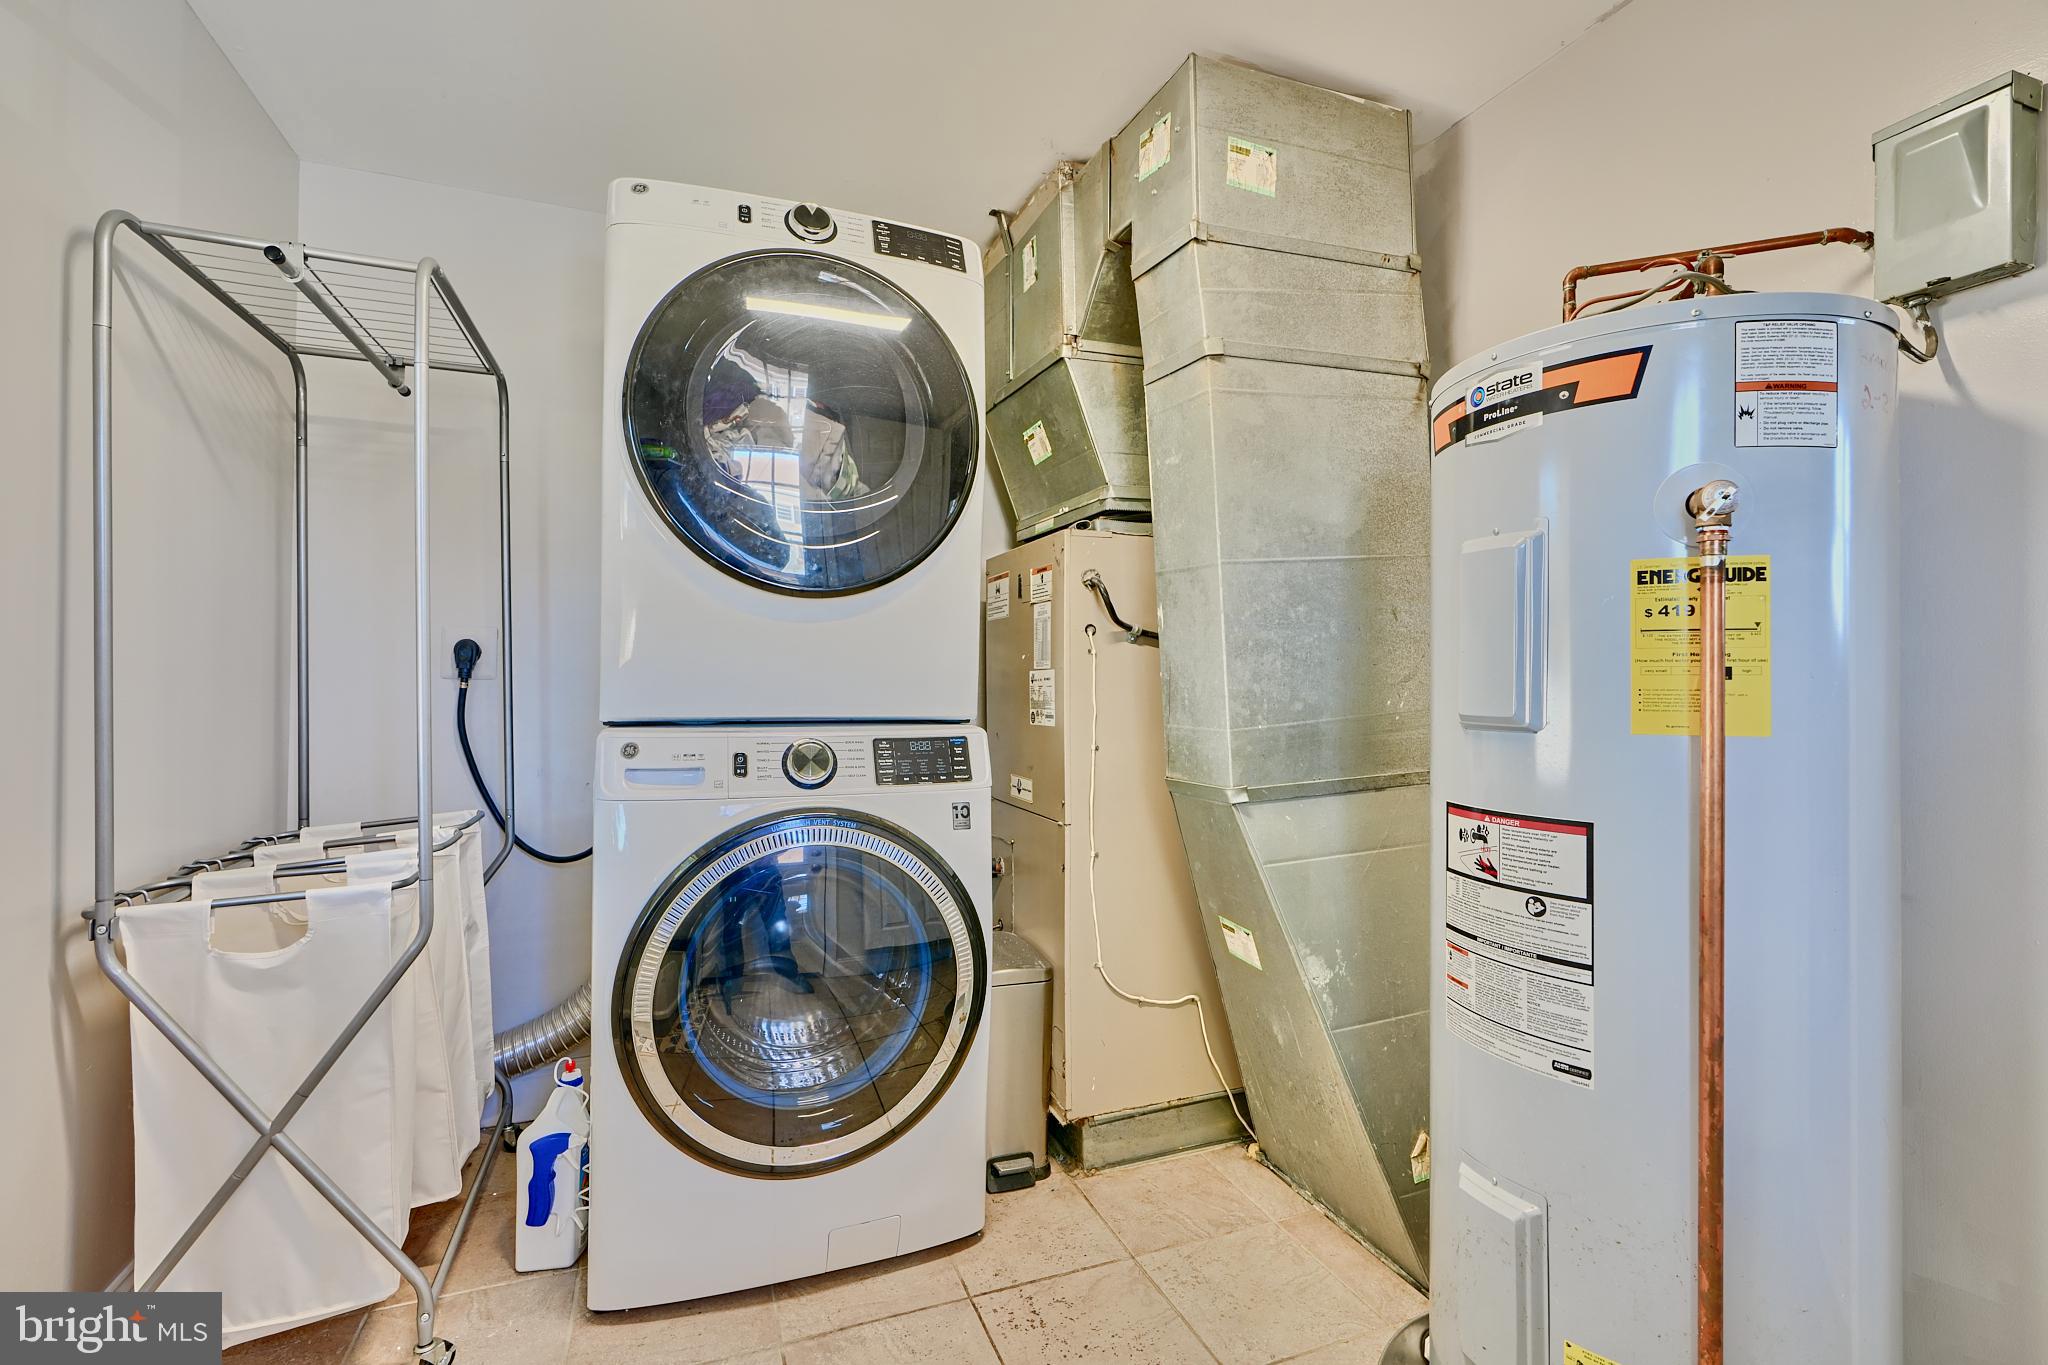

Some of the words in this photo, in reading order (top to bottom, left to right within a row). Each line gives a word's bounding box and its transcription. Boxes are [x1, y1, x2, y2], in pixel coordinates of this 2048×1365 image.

[1486, 372, 1532, 396] state
[1474, 426, 1505, 439] COMMERCIAL
[1507, 420, 1526, 429] GRADE
[1644, 608, 1653, 618] $
[1658, 604, 1696, 616] 419
[832, 820, 856, 829] SYSTEM
[1492, 817, 1520, 826] DANGER
